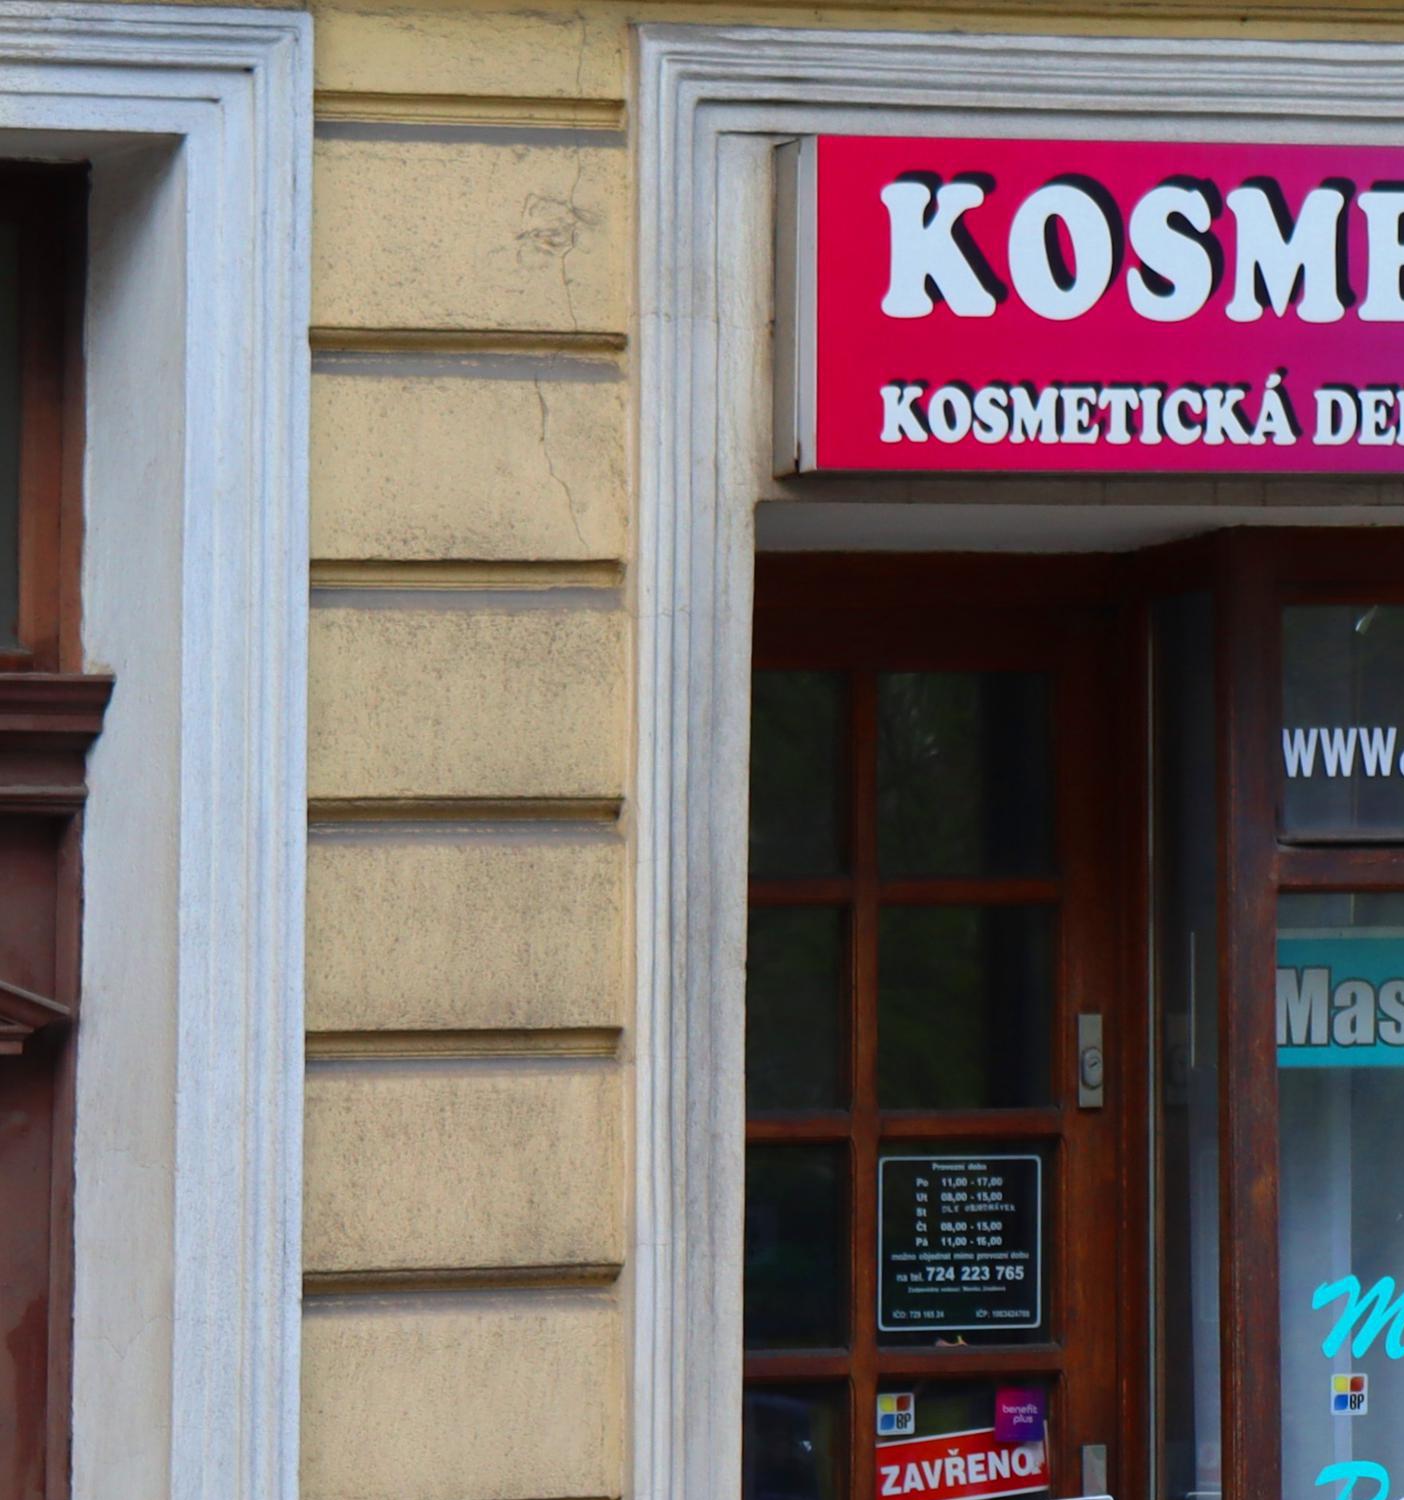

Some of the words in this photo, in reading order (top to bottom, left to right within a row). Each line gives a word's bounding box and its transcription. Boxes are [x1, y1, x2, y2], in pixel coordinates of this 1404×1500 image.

[880, 373, 1298, 448] KOSMETICKÁ
[916, 1178, 929, 1187] Po
[926, 1266, 955, 1281] 724
[960, 1266, 990, 1281] 223
[995, 1265, 1025, 1280] 765
[1002, 1403, 1039, 1414] benefit
[1349, 1393, 1365, 1410] BP
[896, 1412, 912, 1430] BP
[1012, 1414, 1034, 1426] plus
[879, 1446, 1035, 1497] ZAVŘENO
